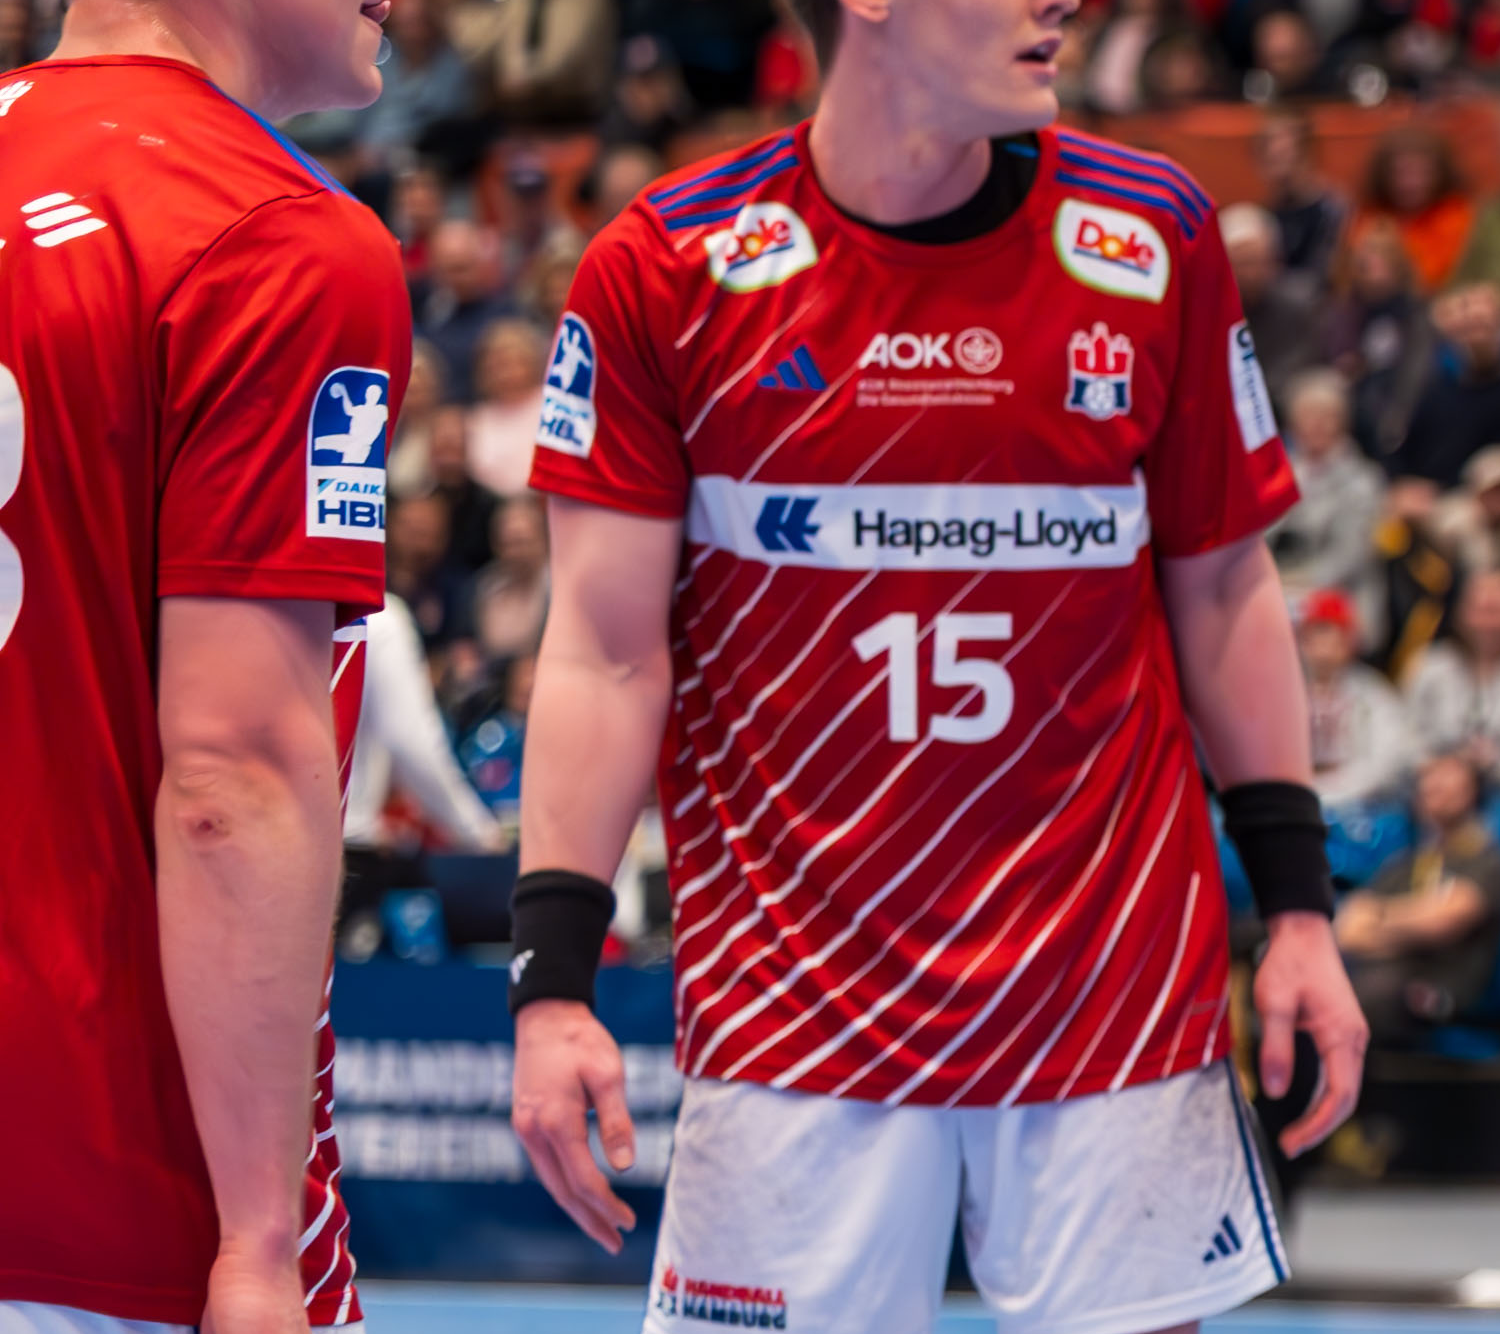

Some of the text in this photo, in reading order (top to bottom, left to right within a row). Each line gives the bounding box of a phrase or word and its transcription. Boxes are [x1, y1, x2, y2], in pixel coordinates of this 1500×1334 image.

[1075, 219, 1157, 269] Dole
[858, 332, 953, 370] AOK
[335, 481, 386, 496] DAIK
[854, 510, 1117, 556] Hapag-Lloyd
[852, 612, 1014, 744] 15
